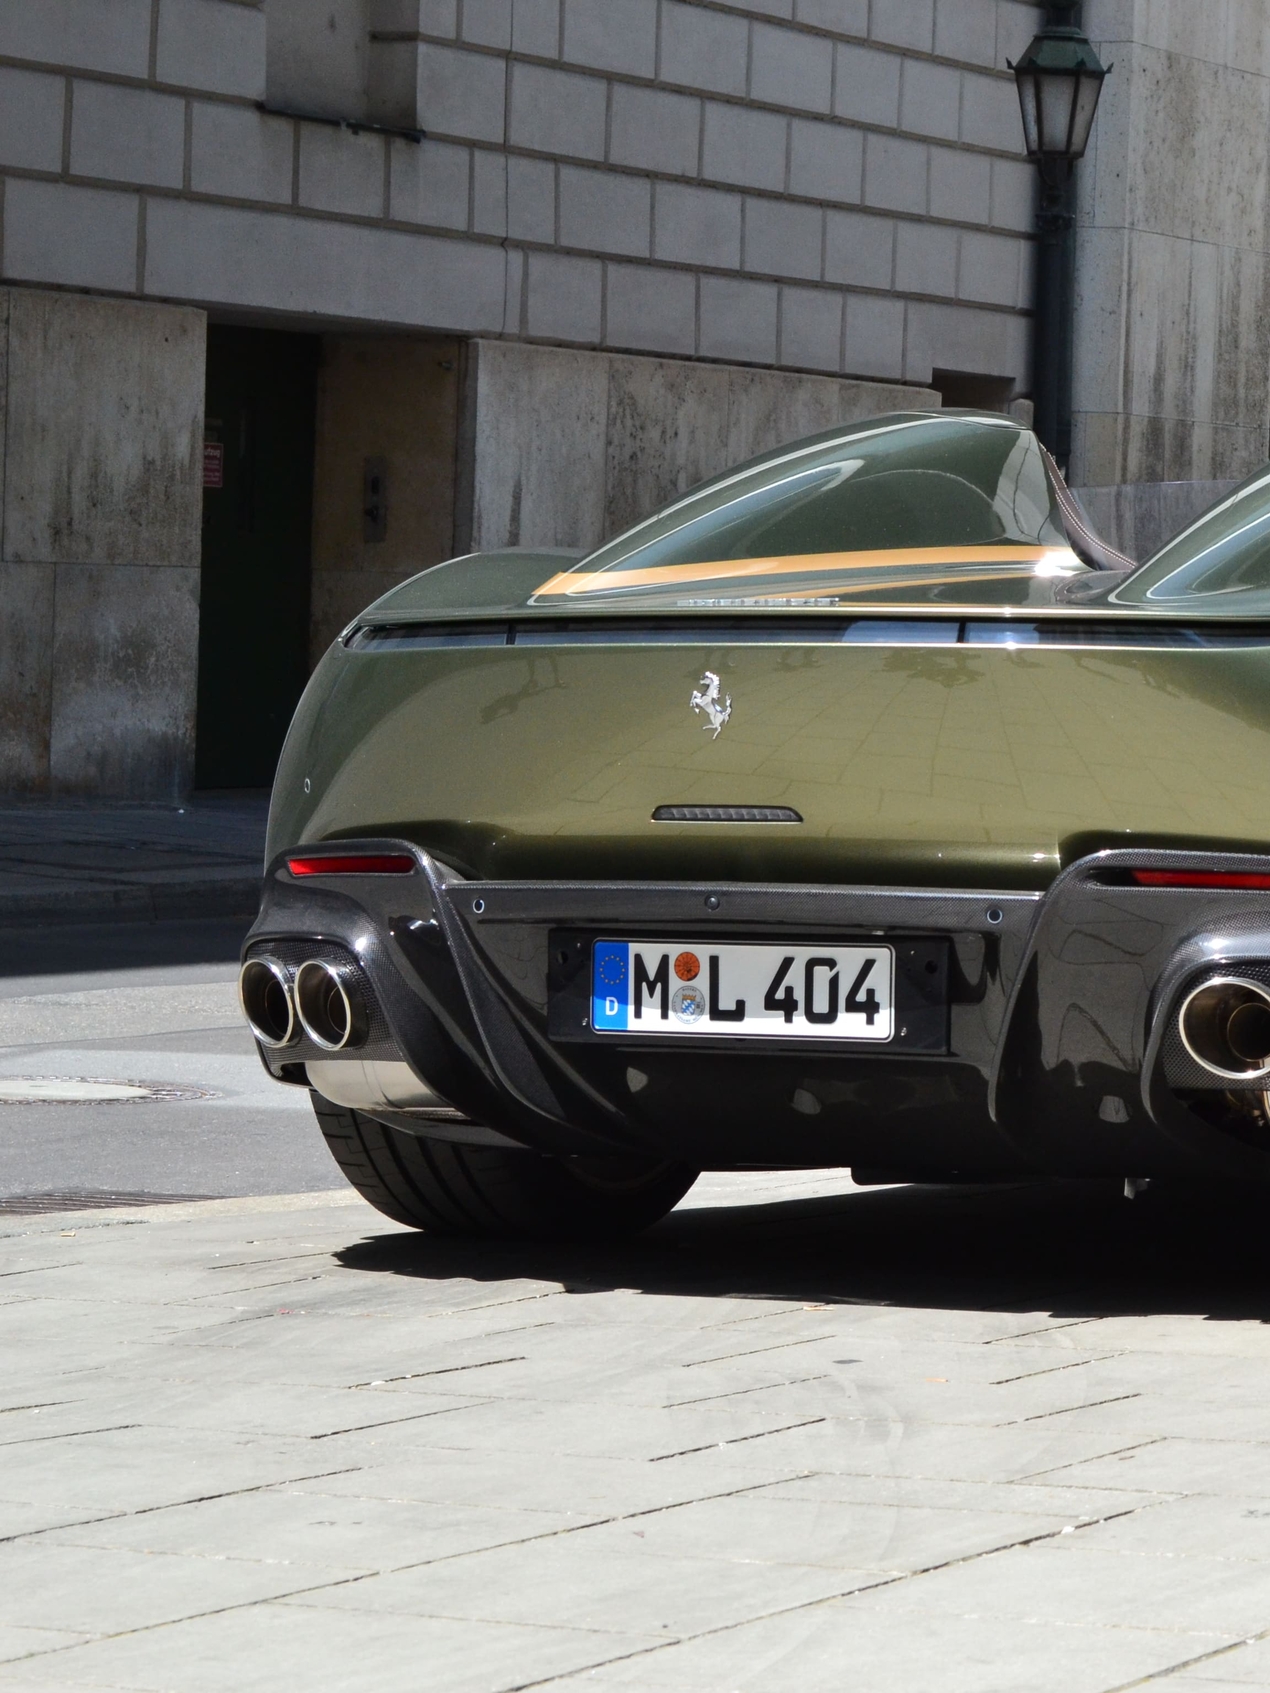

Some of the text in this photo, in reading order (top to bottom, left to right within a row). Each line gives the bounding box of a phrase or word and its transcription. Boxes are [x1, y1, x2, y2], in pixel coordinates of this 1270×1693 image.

[605, 996, 618, 1016] D
[633, 953, 670, 1020] M
[709, 955, 746, 1022] L
[763, 956, 880, 1025] 404
